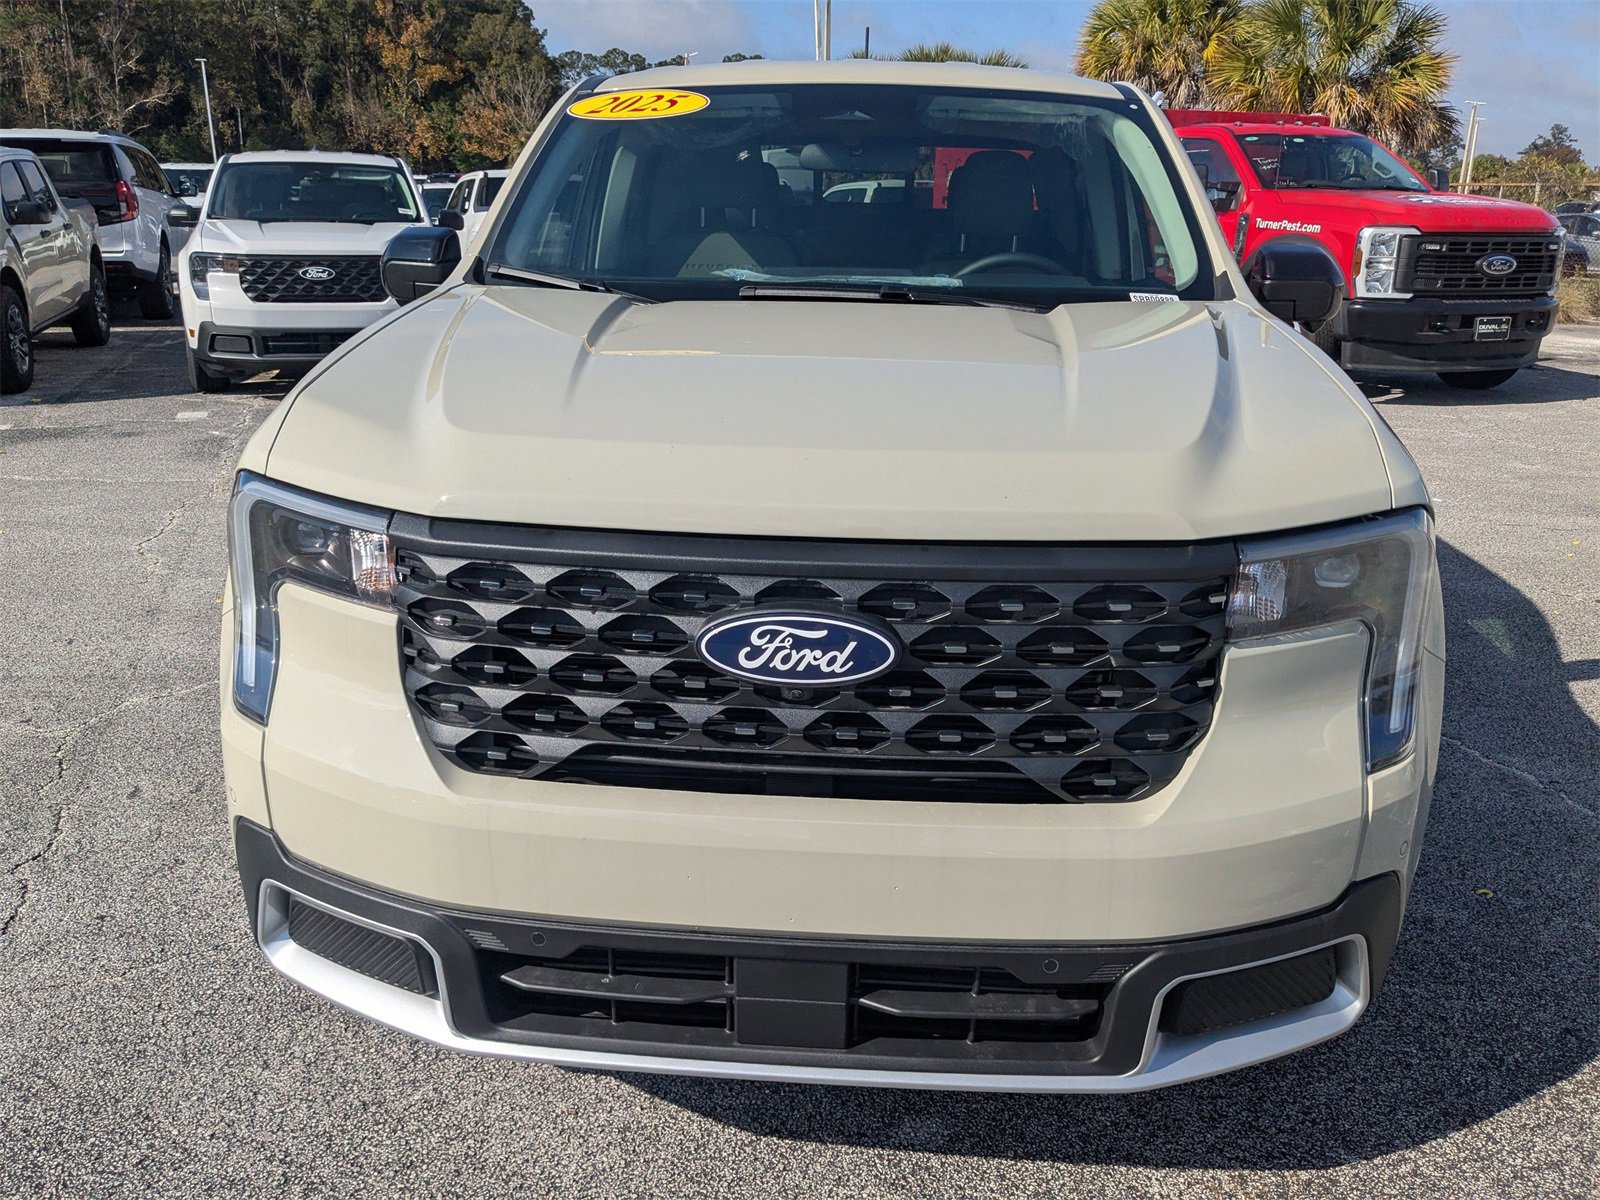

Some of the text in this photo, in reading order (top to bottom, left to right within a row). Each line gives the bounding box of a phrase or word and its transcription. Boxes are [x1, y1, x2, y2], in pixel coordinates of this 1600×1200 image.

[584, 95, 690, 114] 2025
[1255, 217, 1321, 233] TurnerPest.com
[738, 625, 858, 674] Ford
